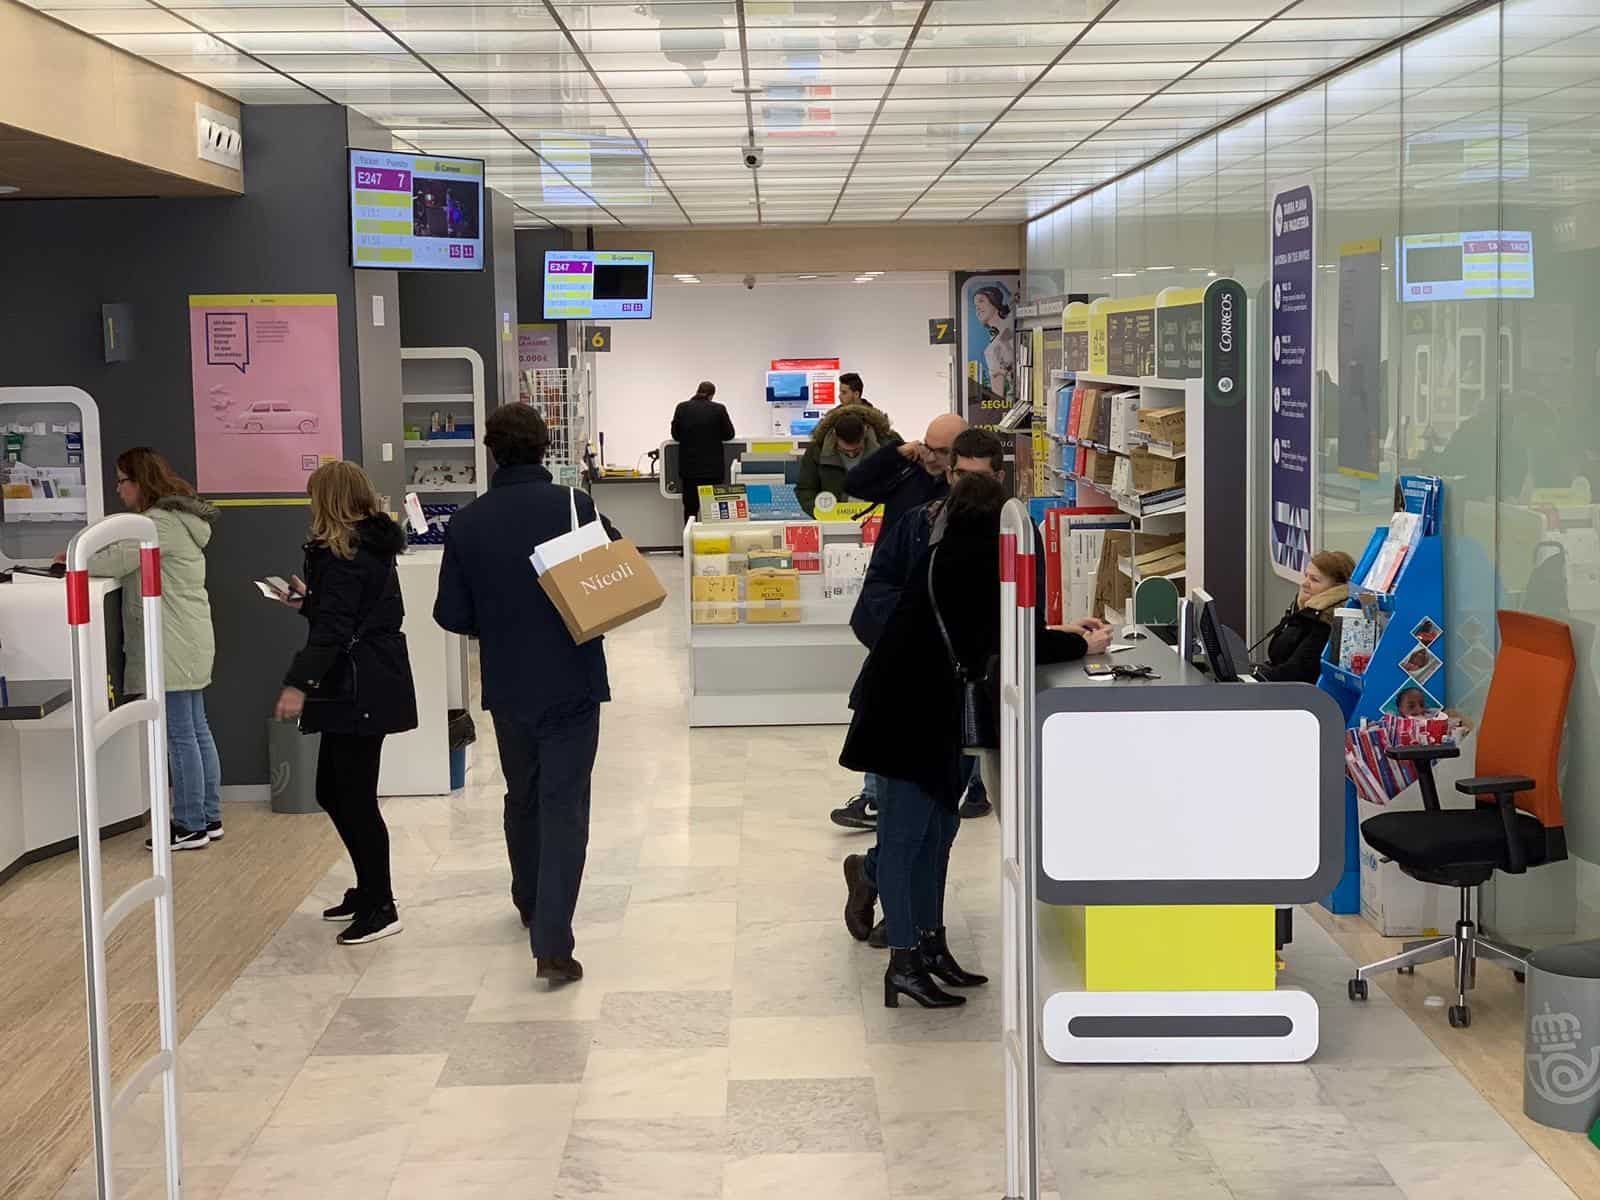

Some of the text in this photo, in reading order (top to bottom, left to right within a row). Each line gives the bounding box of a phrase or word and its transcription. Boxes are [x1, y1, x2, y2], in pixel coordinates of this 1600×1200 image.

[358, 171, 405, 188] E247 7
[451, 246, 473, 257] 15 11
[550, 263, 588, 272] E247 7
[1219, 292, 1233, 352] CORREOS
[937, 324, 948, 339] 7
[592, 332, 604, 347] 6
[981, 400, 1013, 409] SEGUI
[579, 562, 635, 595] Nicoli
